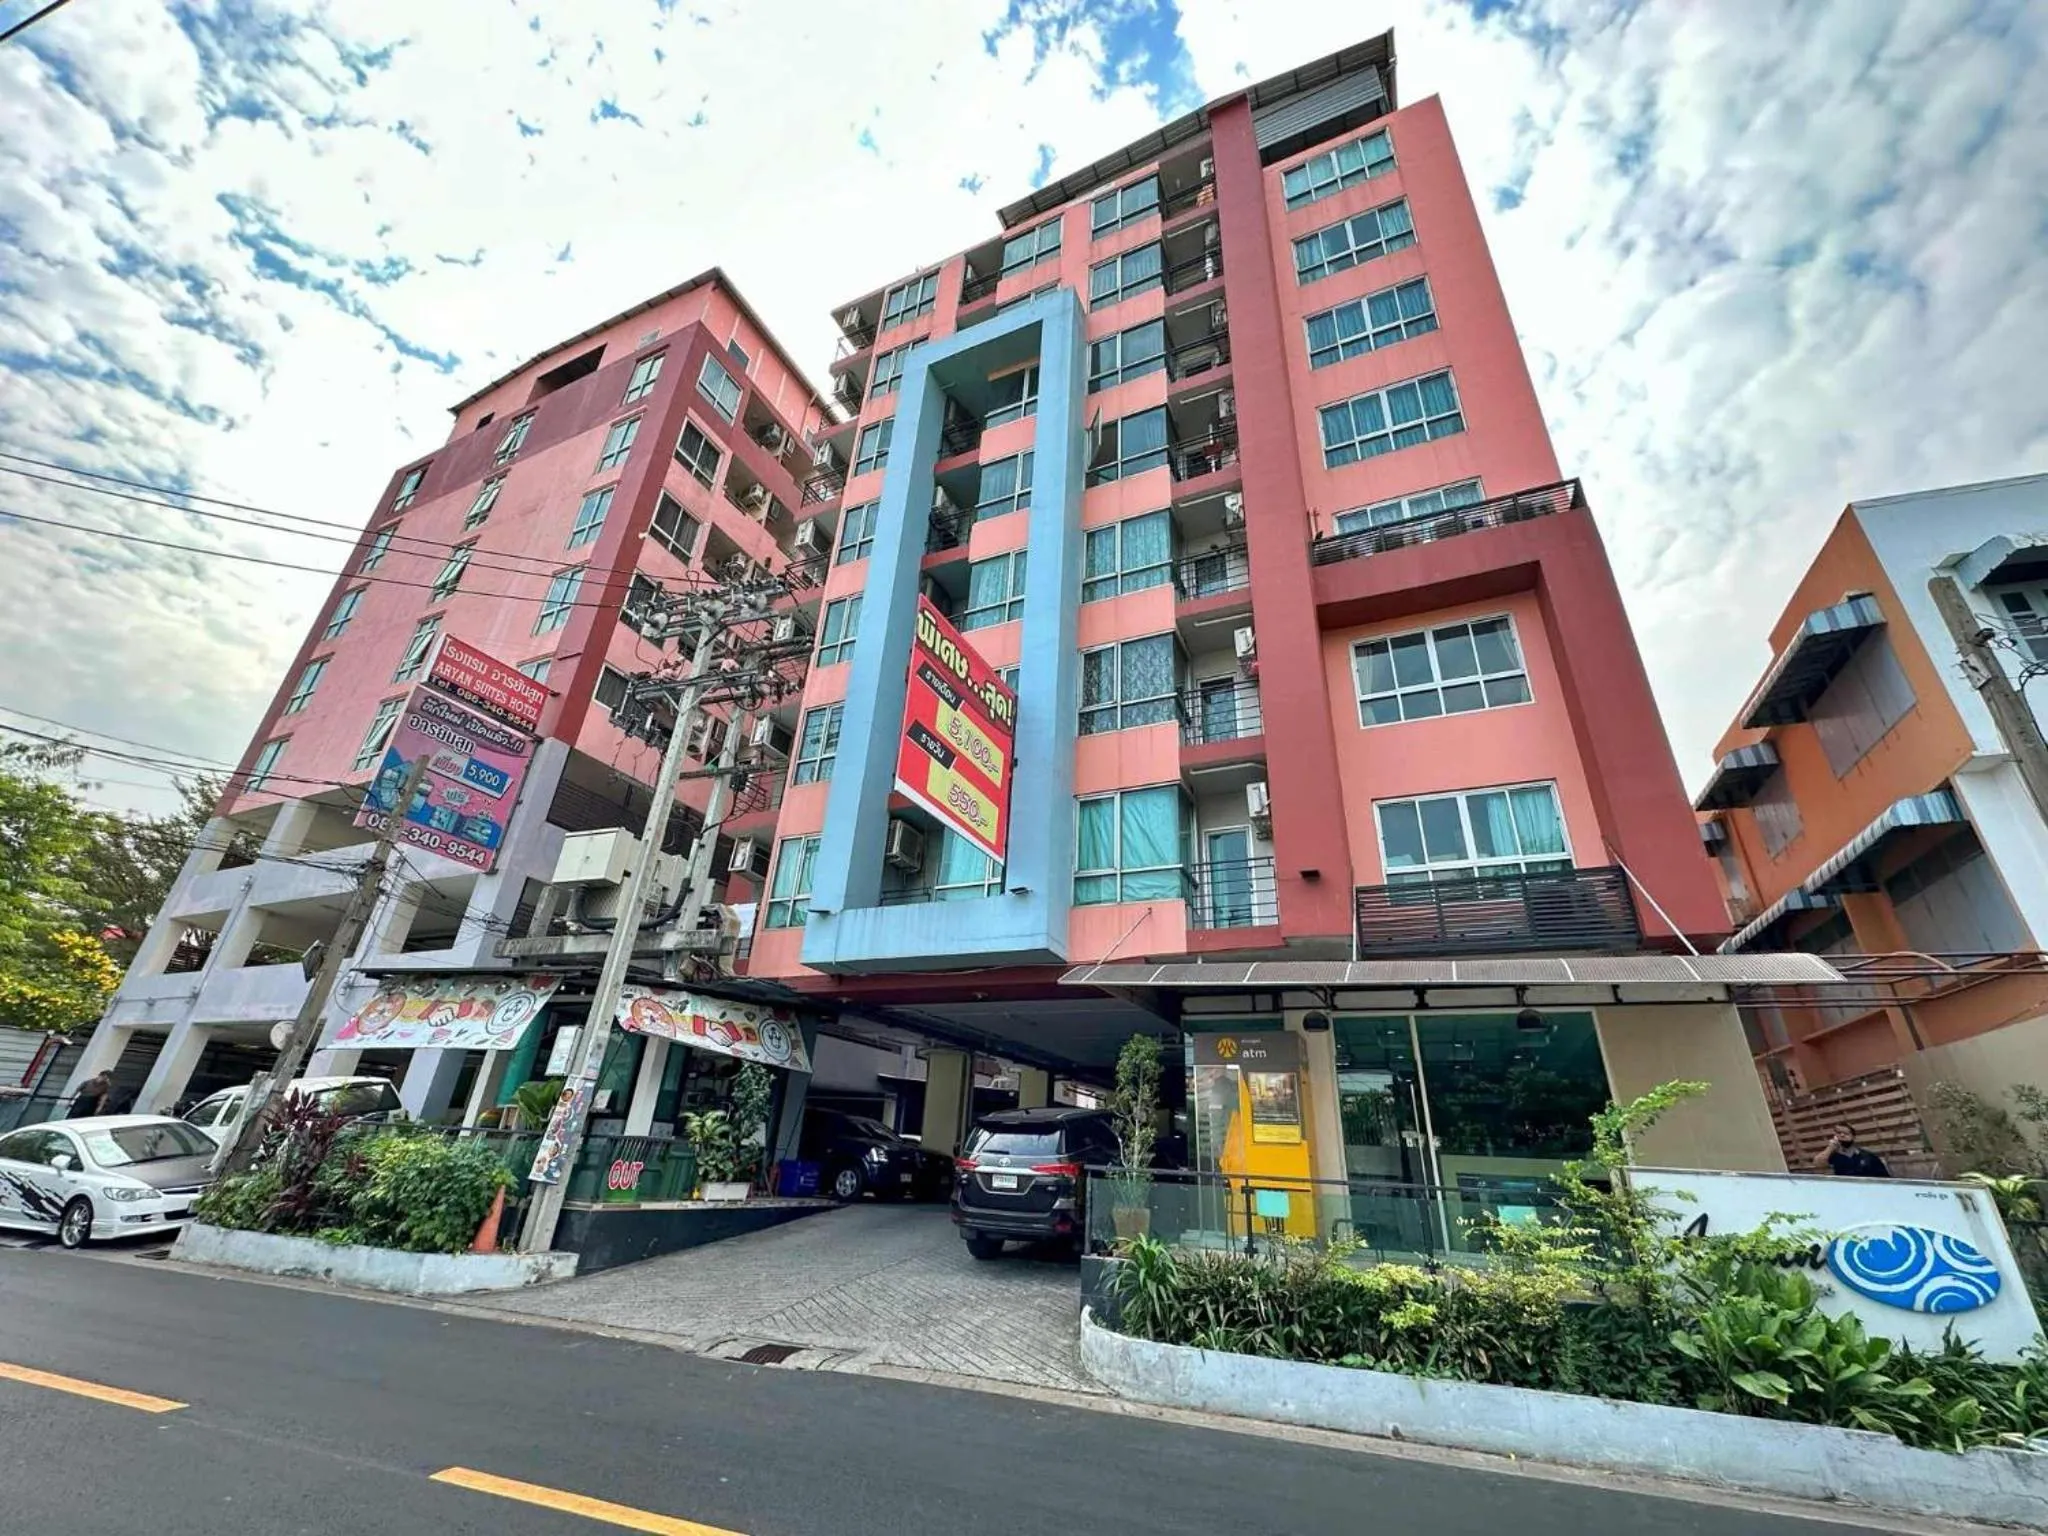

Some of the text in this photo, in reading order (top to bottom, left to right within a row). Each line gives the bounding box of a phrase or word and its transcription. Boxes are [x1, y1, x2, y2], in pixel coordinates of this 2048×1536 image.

[443, 637, 488, 675] โรงแรม
[434, 661, 537, 720] ARYAN SUITES HOTEL
[467, 764, 501, 787] 5,900
[367, 812, 487, 865] 08-340-9544
[1242, 1048, 1267, 1059] atm
[608, 1159, 644, 1190] OUT
